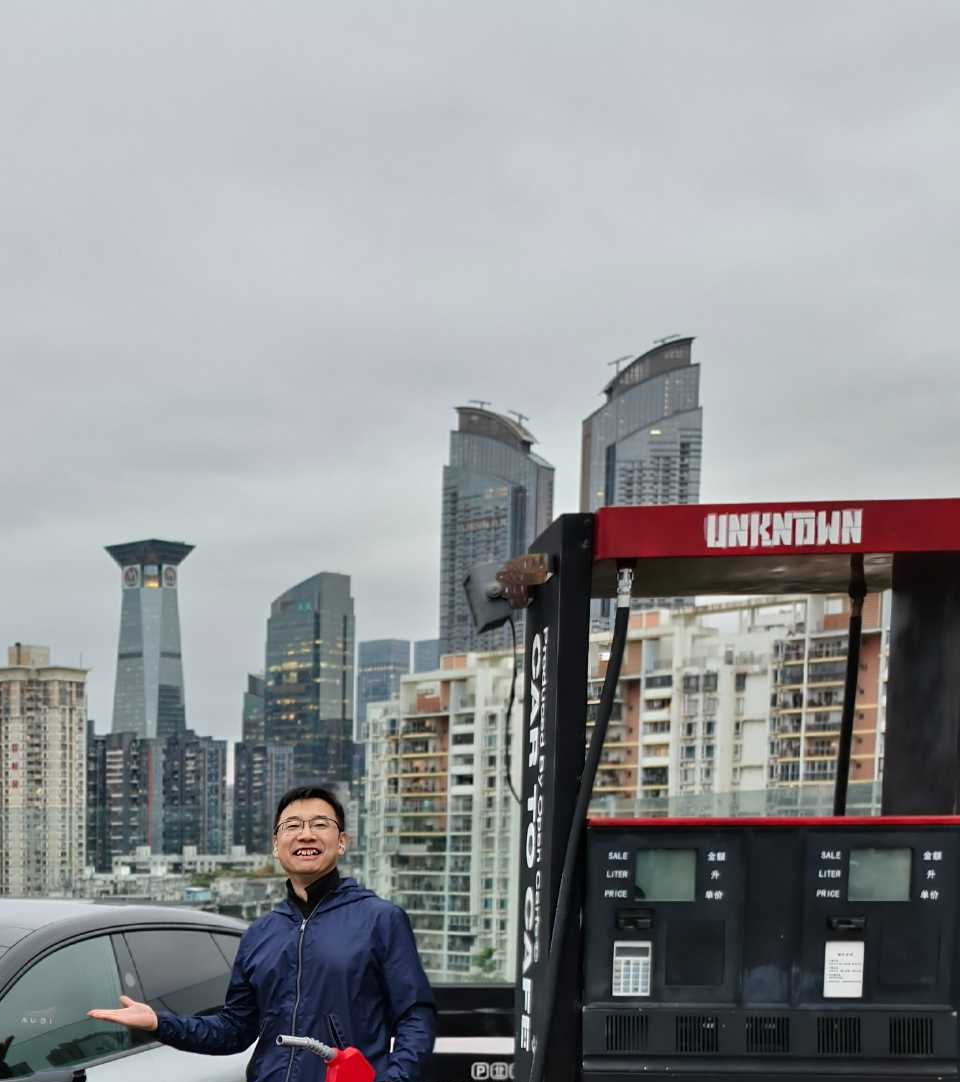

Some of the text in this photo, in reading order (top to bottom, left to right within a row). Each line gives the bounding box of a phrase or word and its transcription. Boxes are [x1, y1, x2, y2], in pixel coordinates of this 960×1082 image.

[705, 509, 863, 548] UNKNOWN
[528, 633, 541, 768] CAR
[526, 783, 538, 869] TO
[608, 851, 628, 861] SALE
[820, 851, 841, 860] SALE
[606, 870, 629, 879] LITER
[818, 869, 841, 878] LITER
[604, 889, 628, 899] PRICE
[816, 889, 840, 898] PRICE
[520, 886, 535, 1052] CAFE
